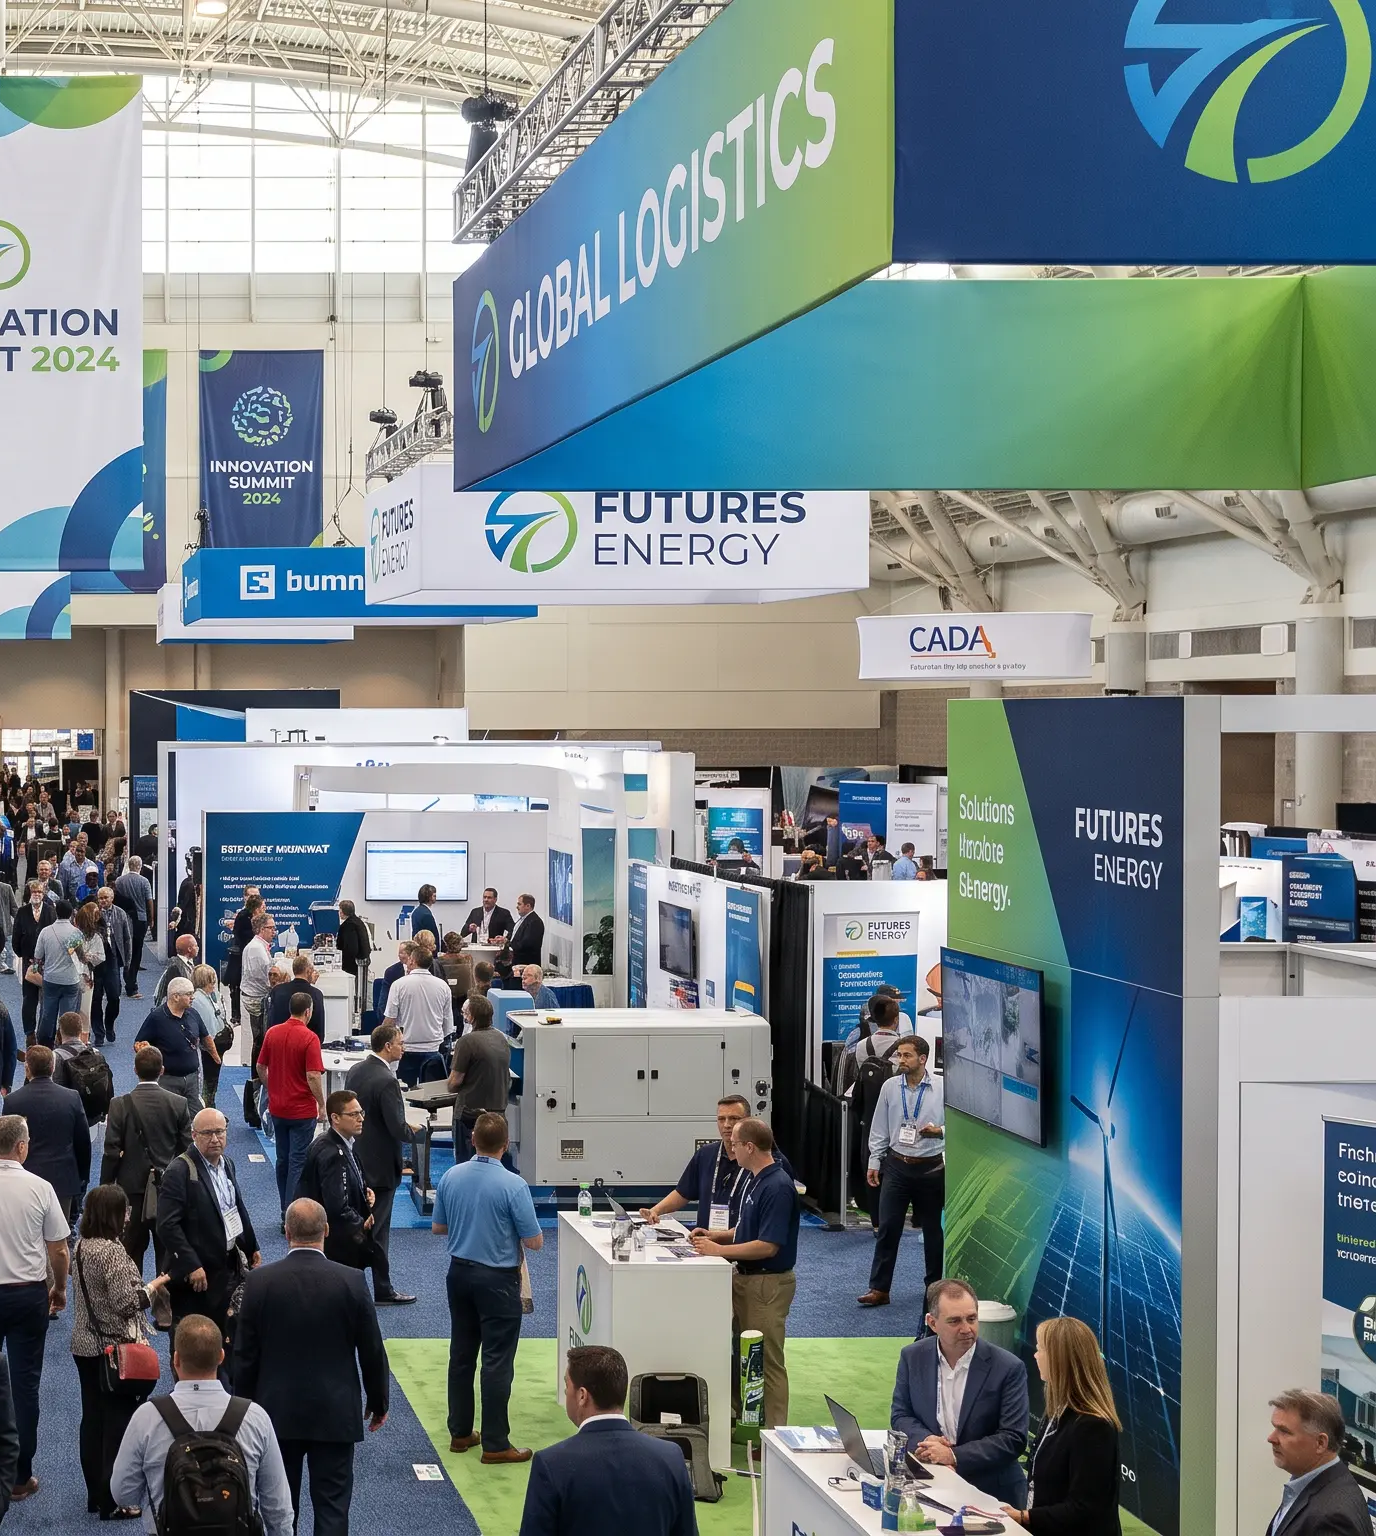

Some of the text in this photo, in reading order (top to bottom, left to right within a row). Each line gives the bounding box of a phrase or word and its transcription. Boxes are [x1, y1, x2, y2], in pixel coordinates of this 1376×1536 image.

[509, 38, 836, 379] GLOBAL LOGISTICS
[31, 346, 120, 373] 2024
[210, 460, 313, 474] INNOVATION
[228, 476, 295, 490] SUMMIT
[242, 492, 282, 505] 2024
[594, 491, 807, 524] FUTURES
[381, 498, 414, 541] FUTURES
[381, 539, 411, 577] ENERGY
[594, 533, 781, 566] ENERGY
[909, 625, 993, 652] CADA
[959, 793, 1015, 826] Solutions
[1075, 807, 1163, 848] FUTURES
[1094, 853, 1163, 890] ENERGY
[868, 921, 911, 931] FUTURES
[868, 931, 908, 940] ENERGY
